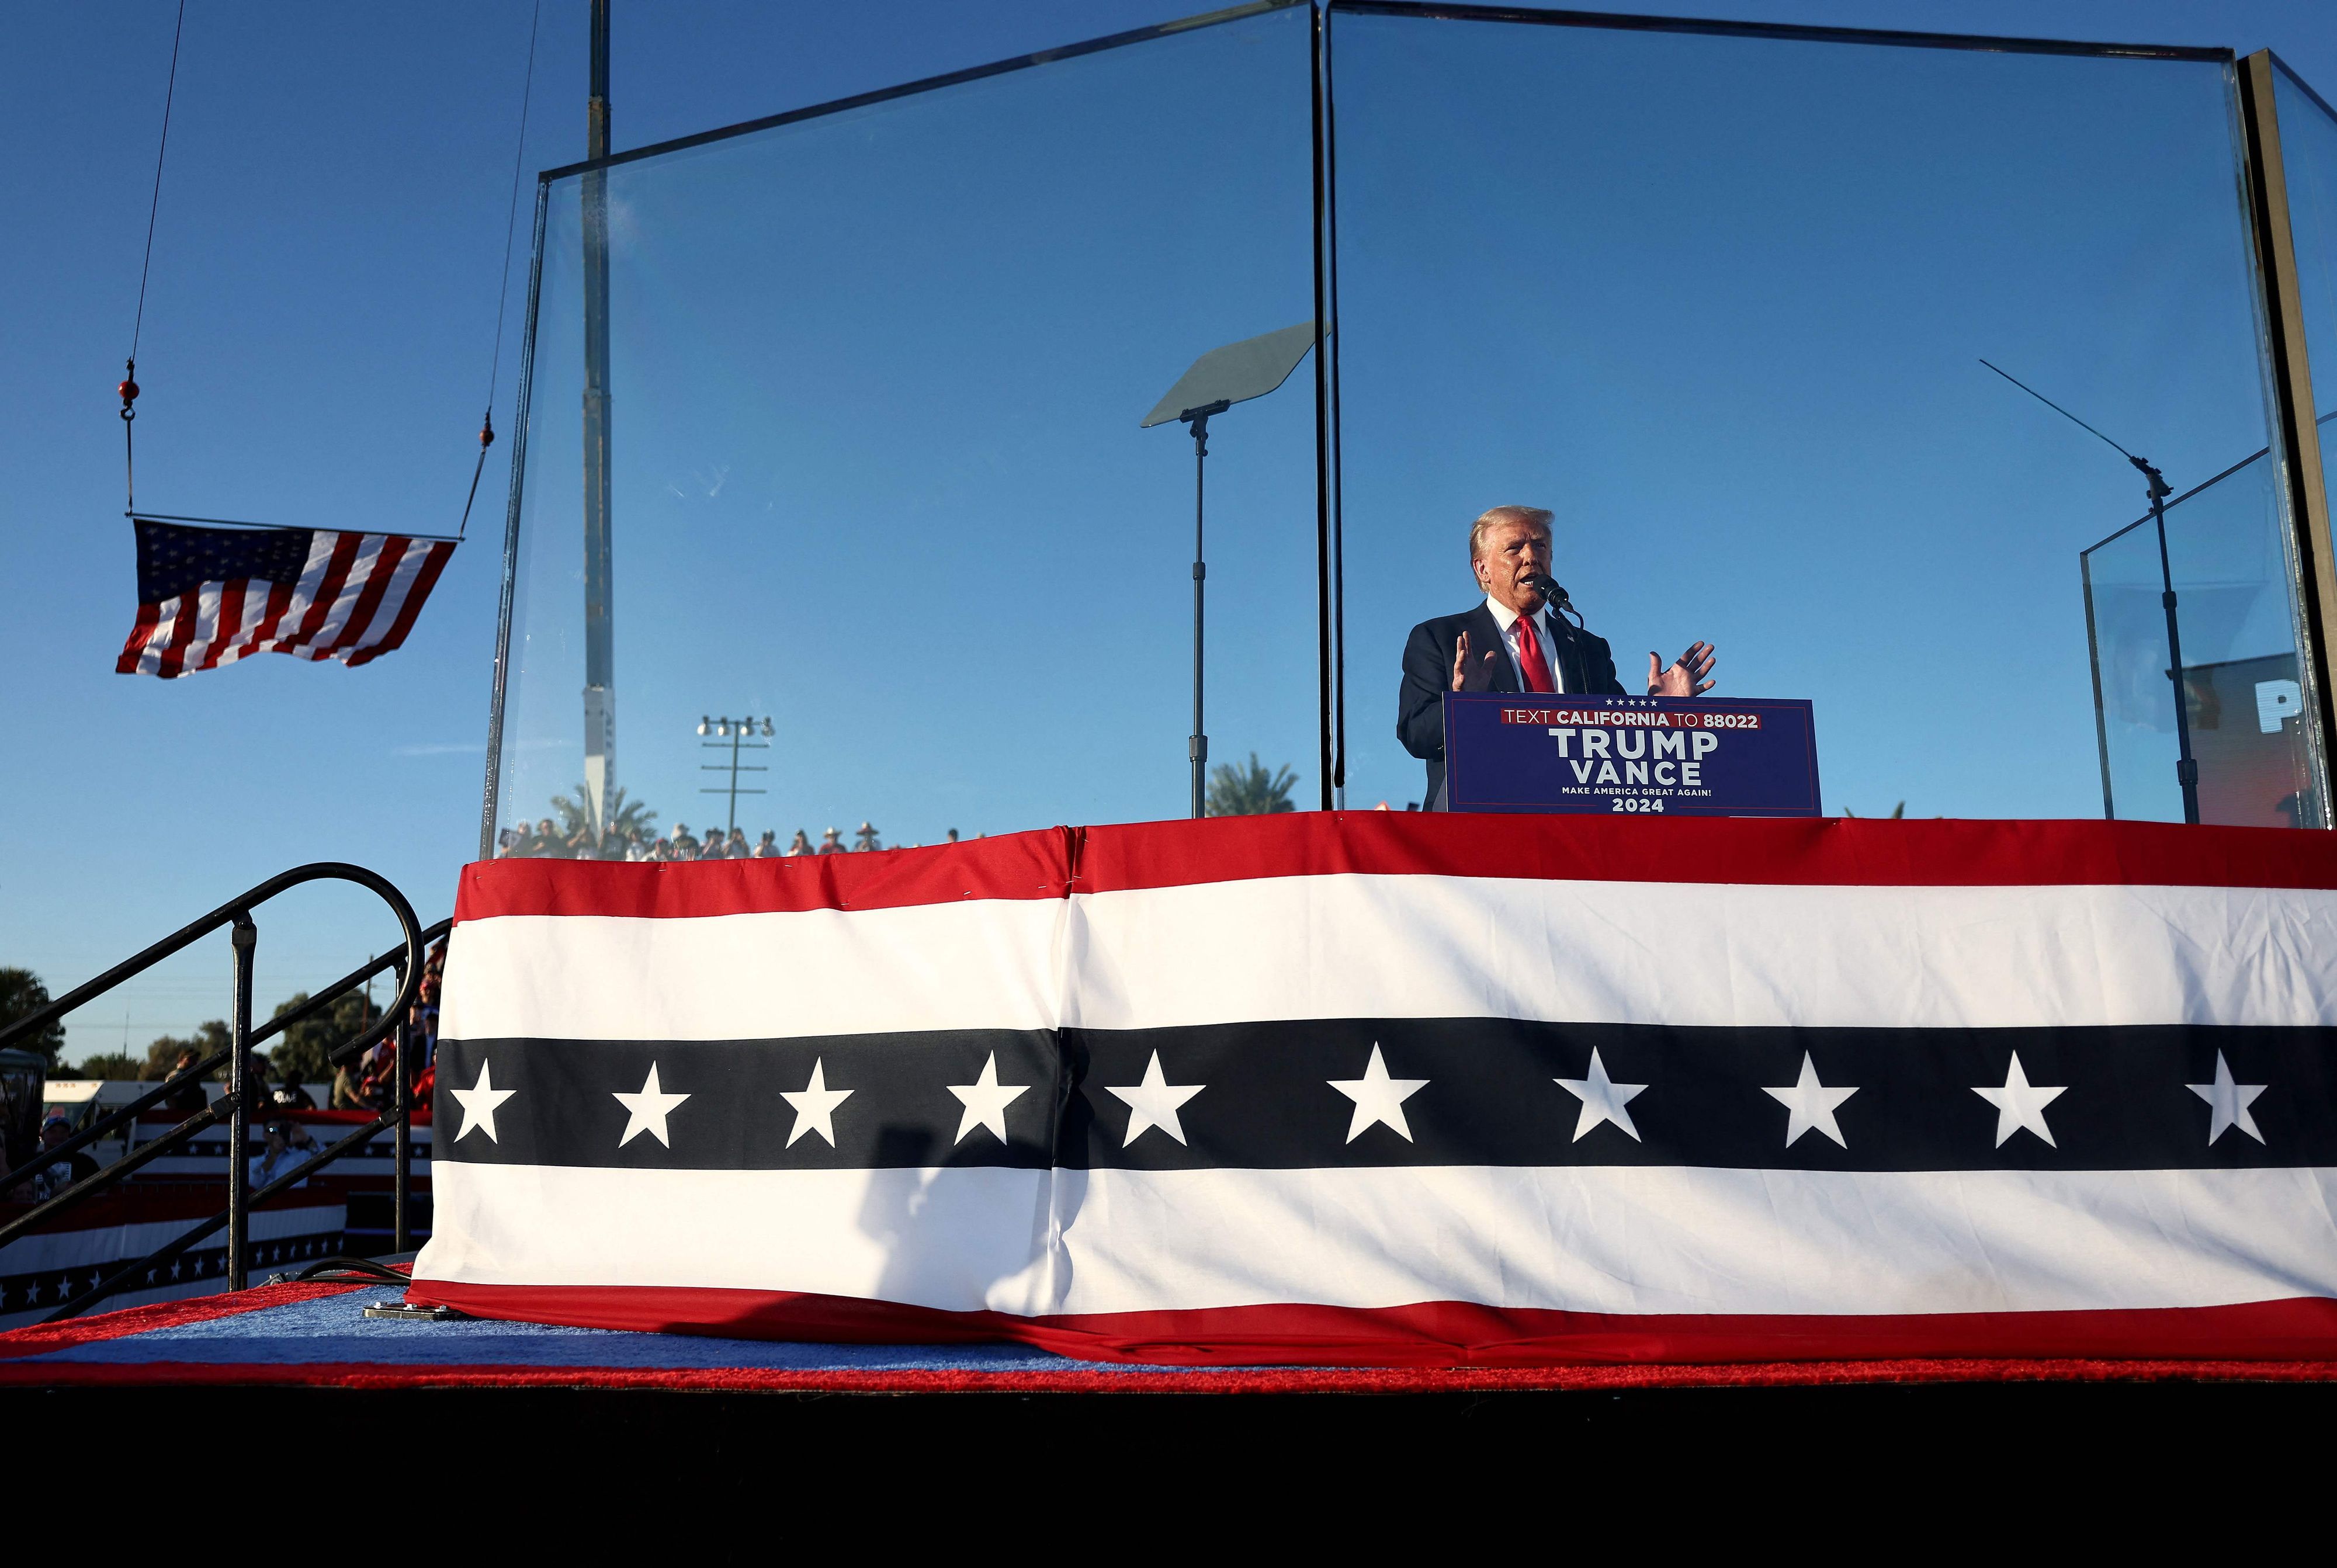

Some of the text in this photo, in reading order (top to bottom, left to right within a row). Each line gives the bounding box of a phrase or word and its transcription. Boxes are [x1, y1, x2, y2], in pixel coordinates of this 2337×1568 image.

[1505, 710, 1758, 728] TEXT CALIFORNIA TO 88022
[1549, 729, 1718, 760] TRUMP
[1570, 761, 1701, 785] VANCE
[1613, 798, 1663, 812] 2024
